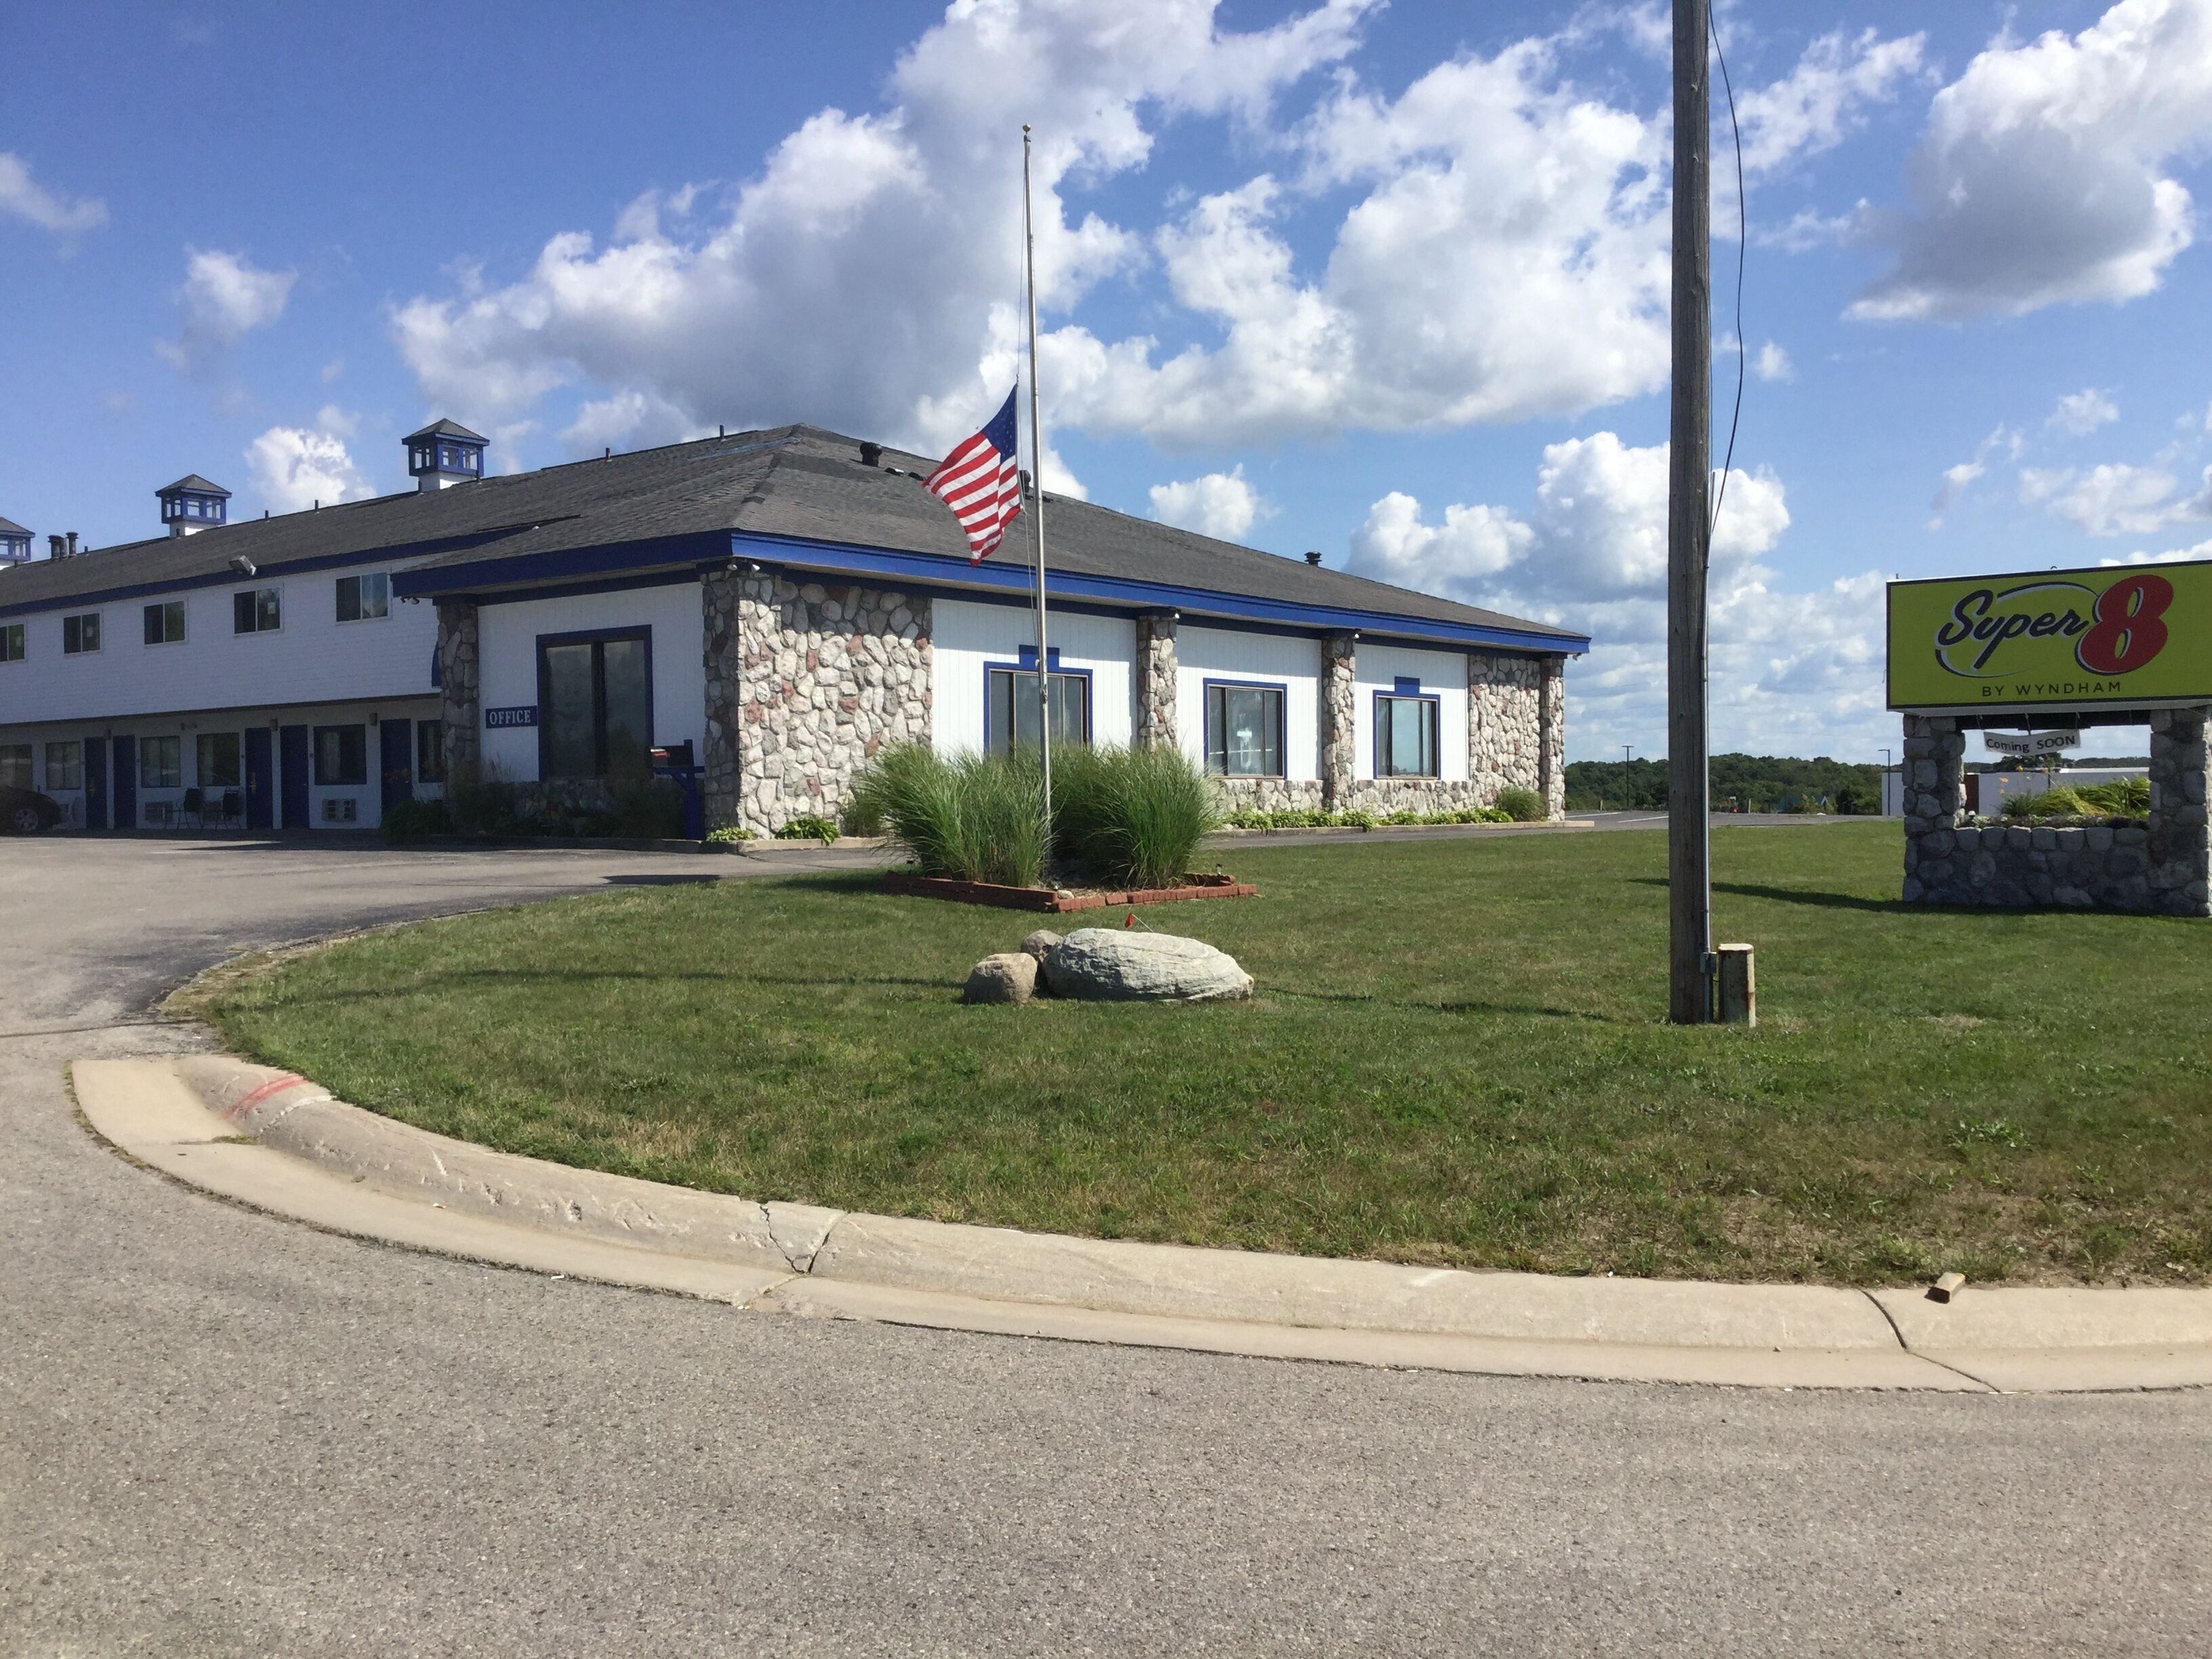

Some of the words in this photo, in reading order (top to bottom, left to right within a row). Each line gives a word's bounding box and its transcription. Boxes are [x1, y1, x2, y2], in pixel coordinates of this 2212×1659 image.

[1936, 588, 2090, 670] Super
[2075, 574, 2174, 675] 8
[1982, 685, 2005, 697] BY
[2016, 681, 2122, 695] WYNDHAM
[489, 710, 531, 725] OFFICE
[1986, 738, 2030, 754] Coming
[2036, 734, 2076, 750] SOON
